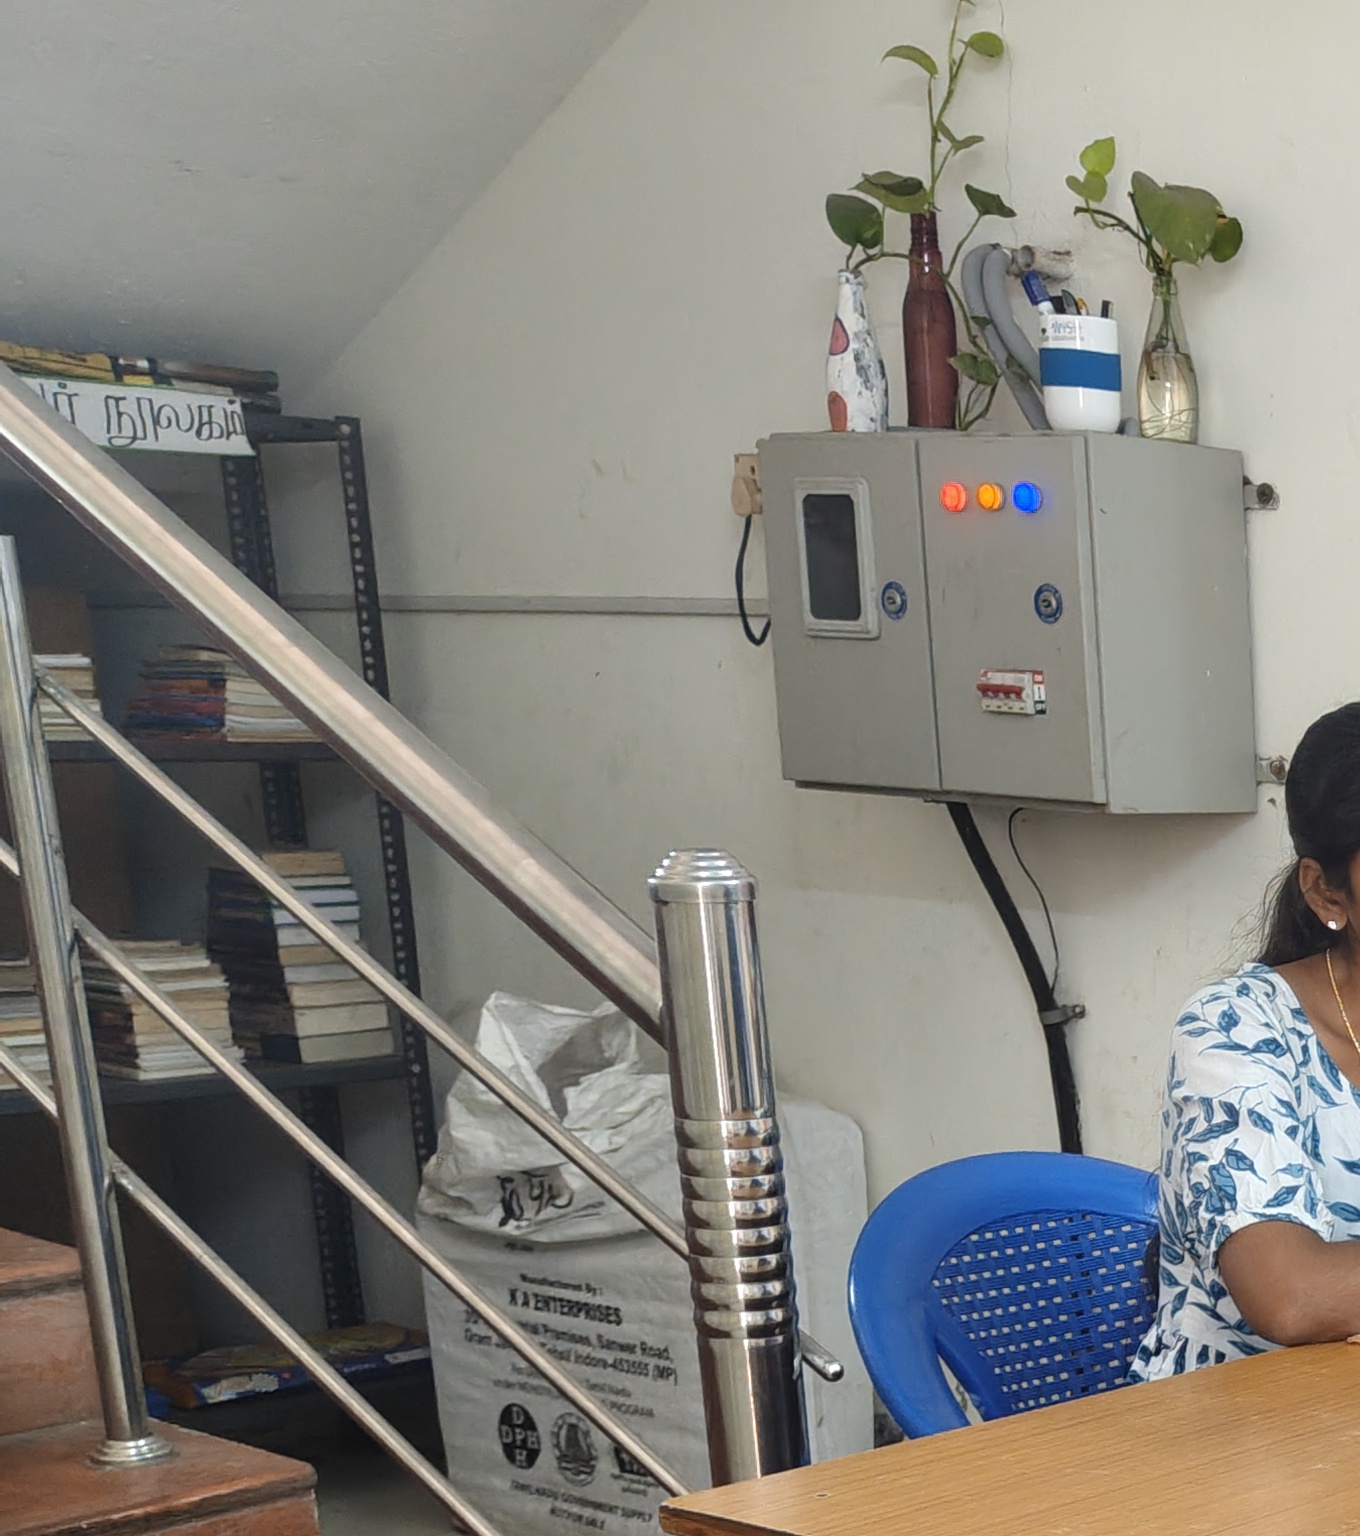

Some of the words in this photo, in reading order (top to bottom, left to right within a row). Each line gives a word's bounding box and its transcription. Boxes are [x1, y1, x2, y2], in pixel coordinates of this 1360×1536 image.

[104, 394, 247, 448] நூலகம்
[520, 1292, 530, 1309] A
[533, 1293, 622, 1327] ENTERPRISES
[640, 1340, 674, 1362] Road,
[652, 1361, 678, 1386] (MP)
[512, 1406, 524, 1425] D
[500, 1424, 540, 1450] DPH
[514, 1448, 527, 1467] H
